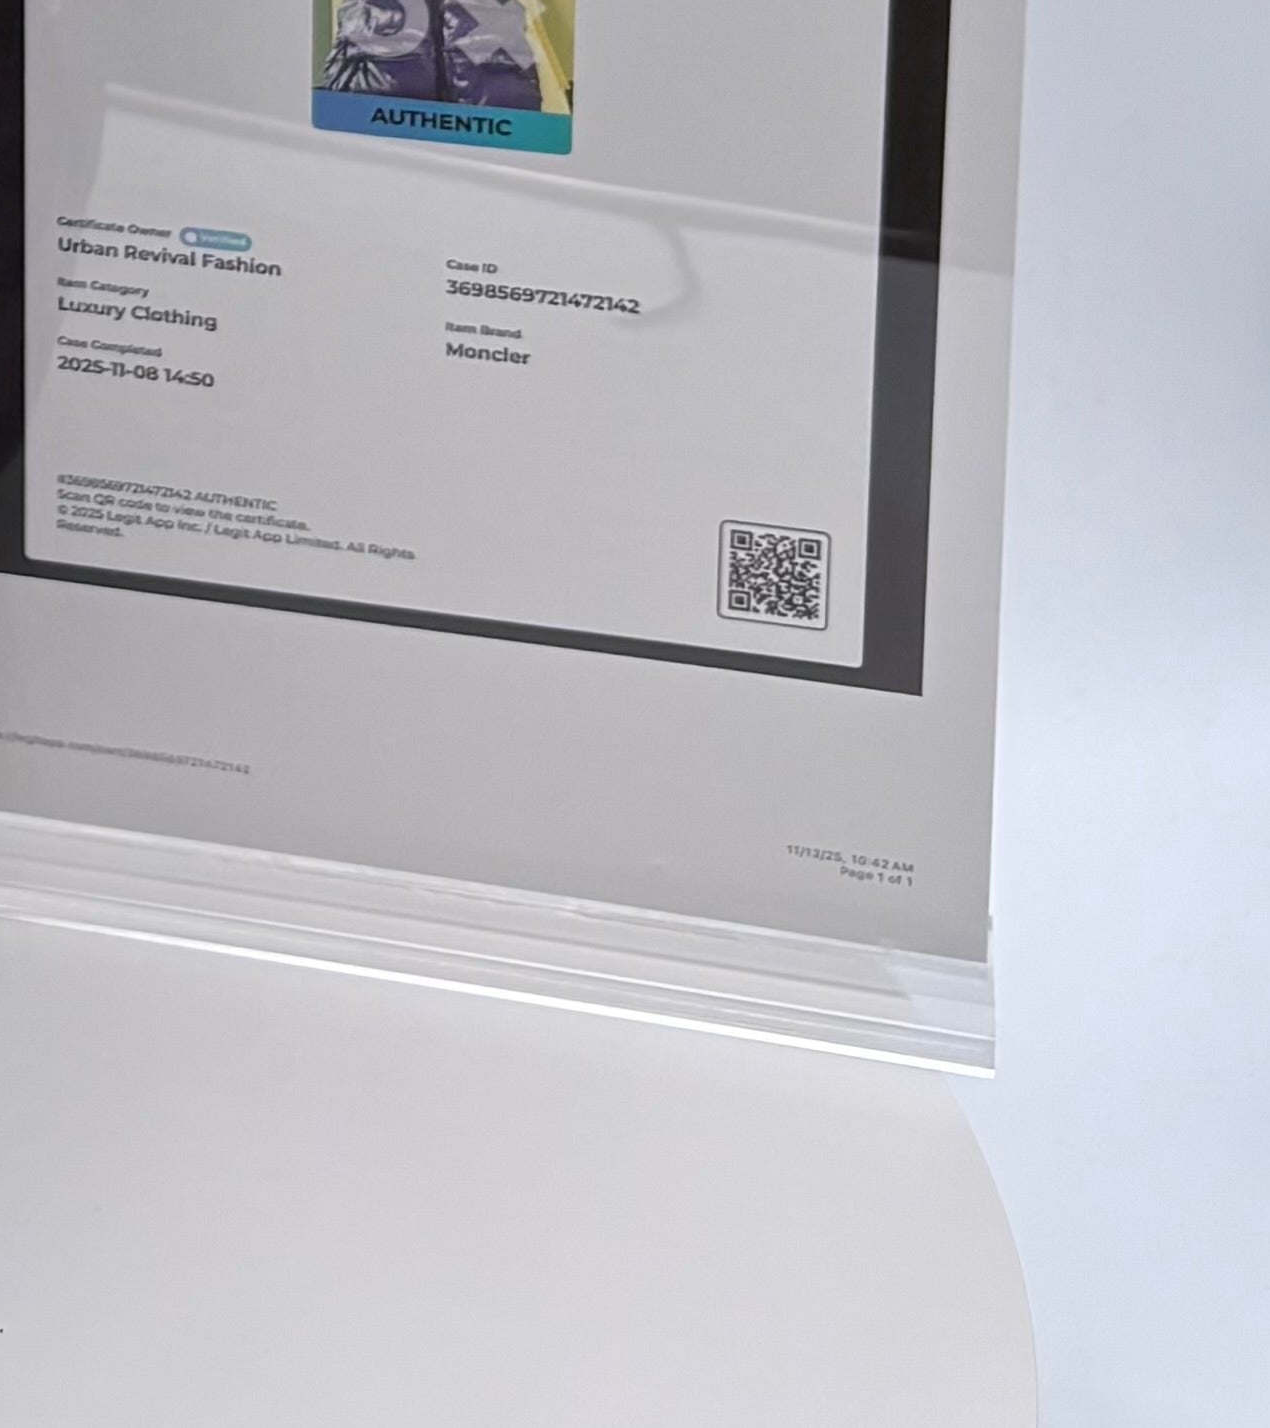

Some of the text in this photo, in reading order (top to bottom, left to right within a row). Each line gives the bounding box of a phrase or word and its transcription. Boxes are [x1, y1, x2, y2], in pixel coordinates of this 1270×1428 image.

[370, 107, 513, 137] AUTHENTIC
[56, 216, 172, 239] Certificate Owner
[57, 236, 282, 277] Urban Revival Fashion
[446, 259, 498, 274] Case ID
[57, 277, 150, 299] Item Category
[446, 279, 641, 315] 3698569721472142
[57, 296, 218, 332] Luxury Clothing
[445, 321, 522, 340] Item Brand
[57, 336, 163, 358] Case Completed
[445, 341, 531, 365] Moncler
[57, 355, 216, 388] 2025-11-08 14:50
[56, 489, 310, 531] Scan QR code to view the certificate.
[195, 492, 277, 511] AUTHENTIC
[70, 505, 104, 520] 2025
[106, 511, 143, 526] Legit
[145, 516, 175, 530] App
[177, 519, 202, 533] Inc.
[213, 523, 251, 541] Legit
[252, 529, 283, 544] App
[346, 541, 365, 553] All
[367, 543, 417, 561] Rights
[839, 865, 875, 882] Page
[887, 874, 902, 885] of
[851, 854, 890, 870] 10:42
[891, 861, 915, 873] AM
